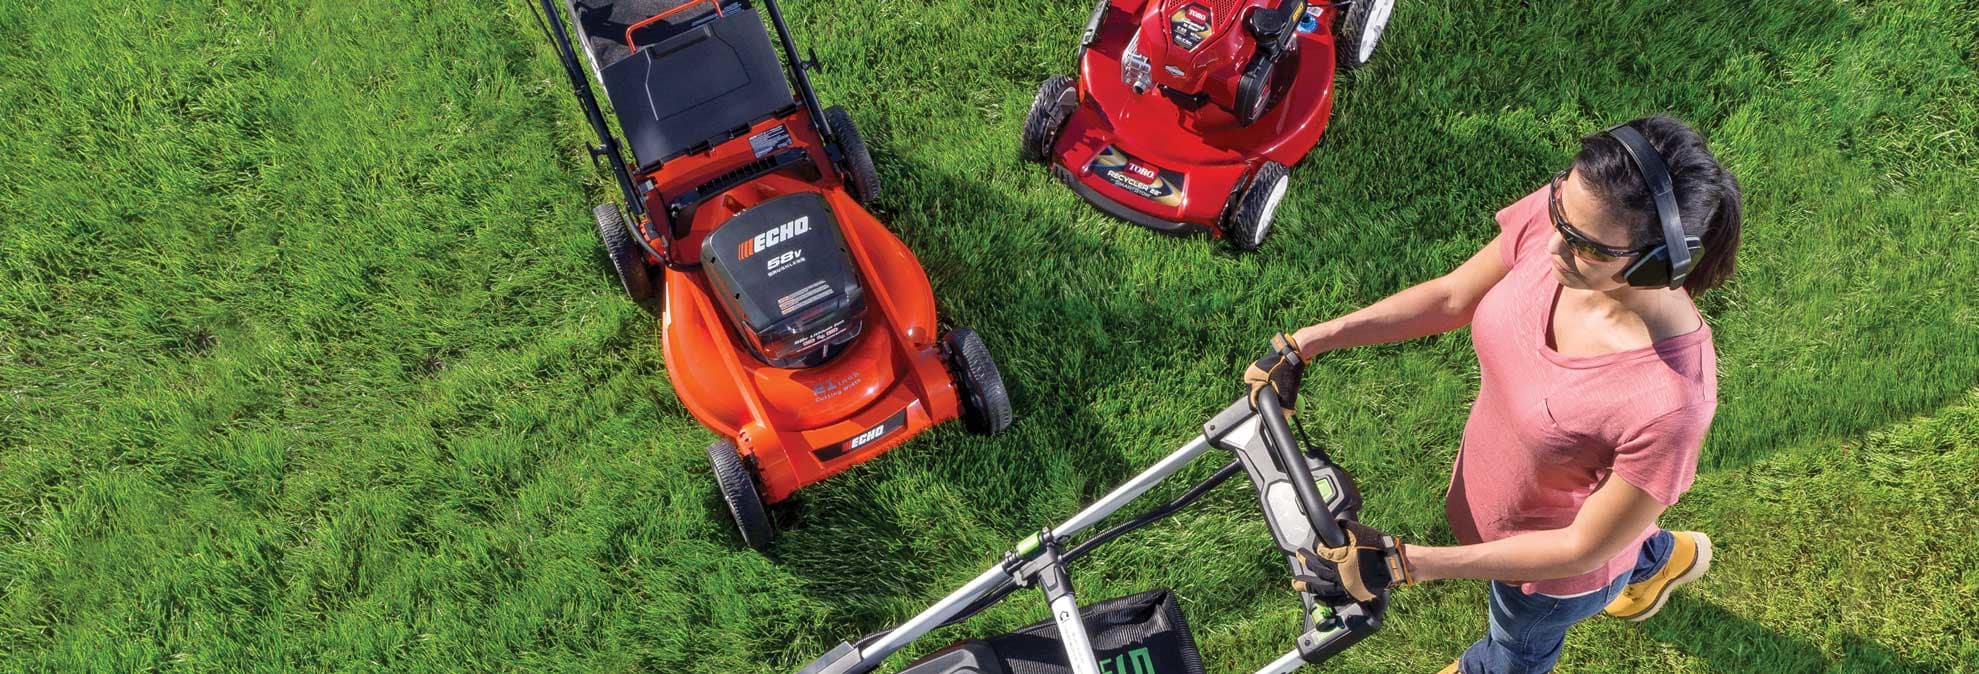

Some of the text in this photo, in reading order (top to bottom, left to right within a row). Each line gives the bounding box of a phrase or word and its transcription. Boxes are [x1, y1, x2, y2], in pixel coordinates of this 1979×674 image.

[1107, 169, 1149, 192] RECYCLER
[1128, 162, 1154, 179] TORO
[754, 215, 809, 254] ECHO
[850, 424, 885, 449] ECHO
